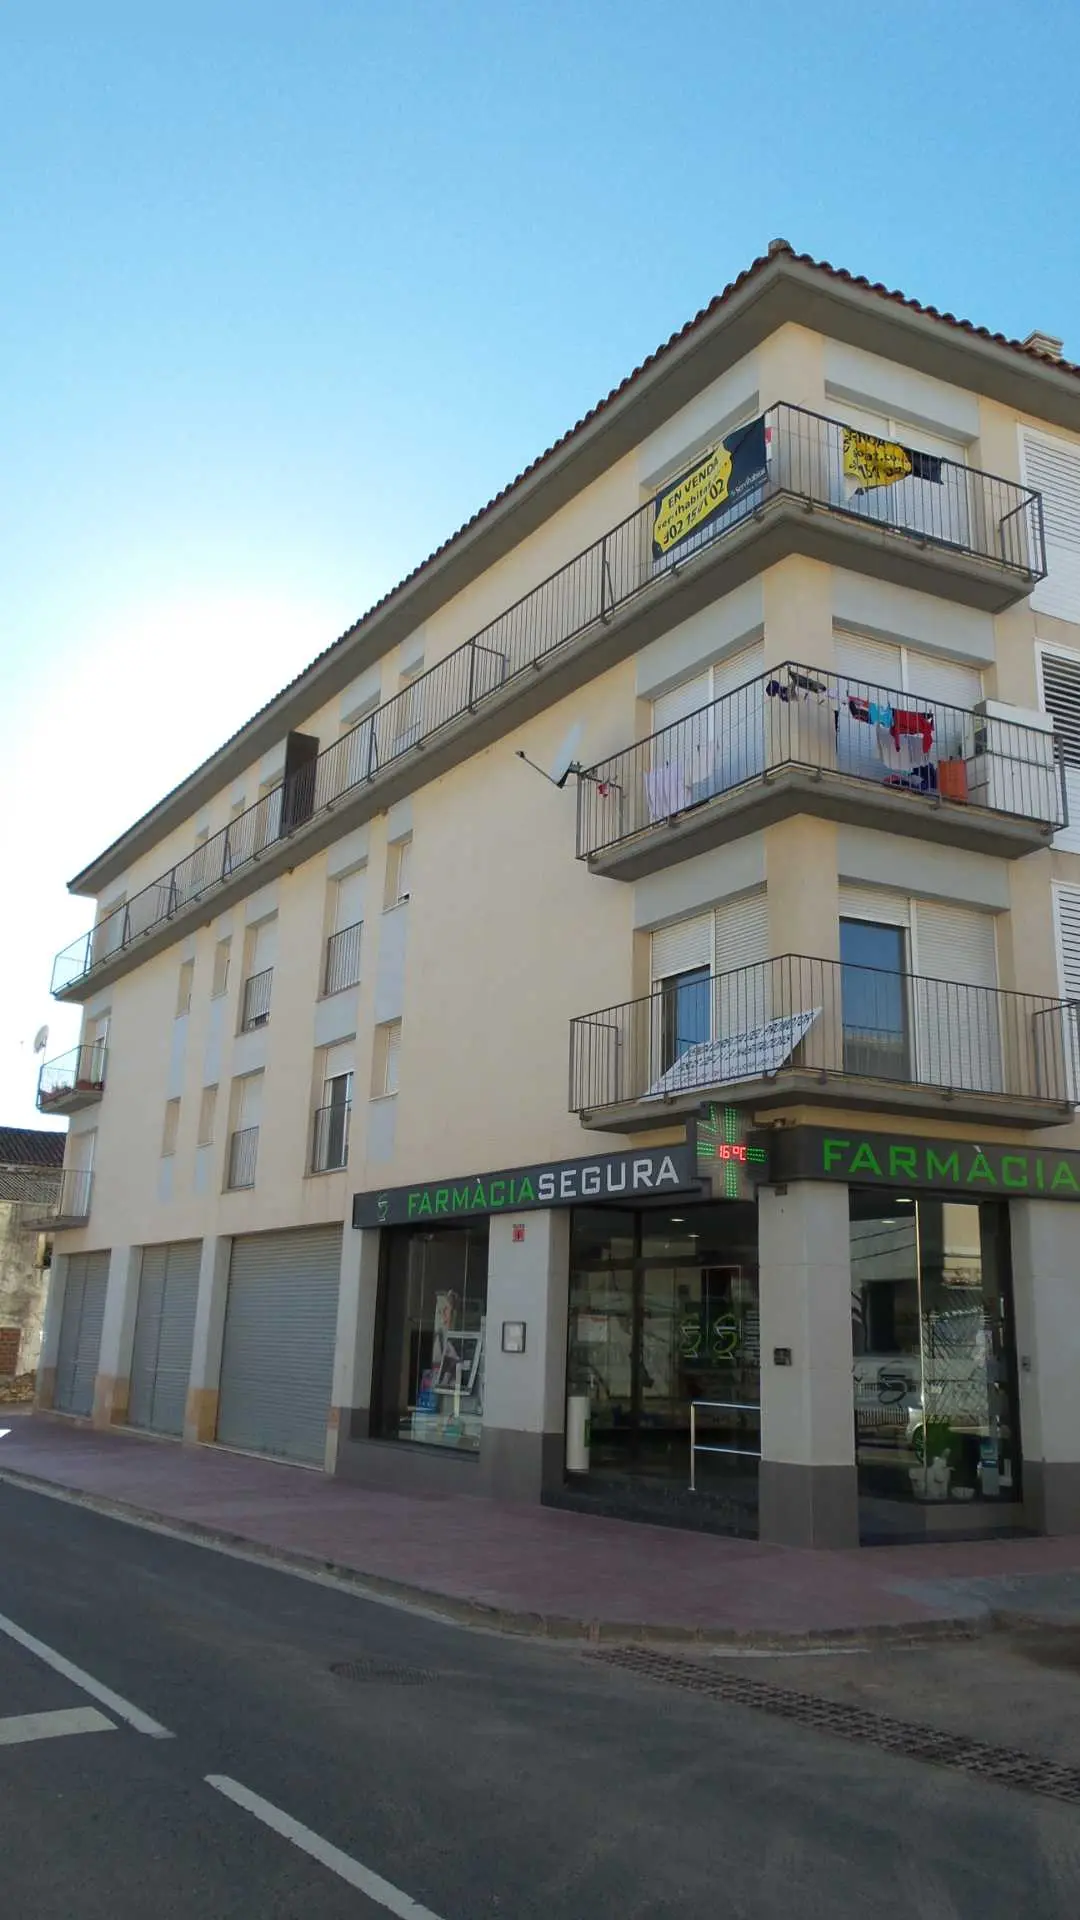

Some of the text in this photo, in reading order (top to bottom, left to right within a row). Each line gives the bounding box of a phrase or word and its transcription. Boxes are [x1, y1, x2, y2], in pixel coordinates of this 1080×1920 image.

[668, 491, 682, 509] EN
[684, 456, 719, 492] VENDA
[710, 478, 725, 501] 02
[407, 1155, 680, 1218] FARMÀCIA SEGURA
[823, 1138, 1080, 1193] FARMÀCIA
